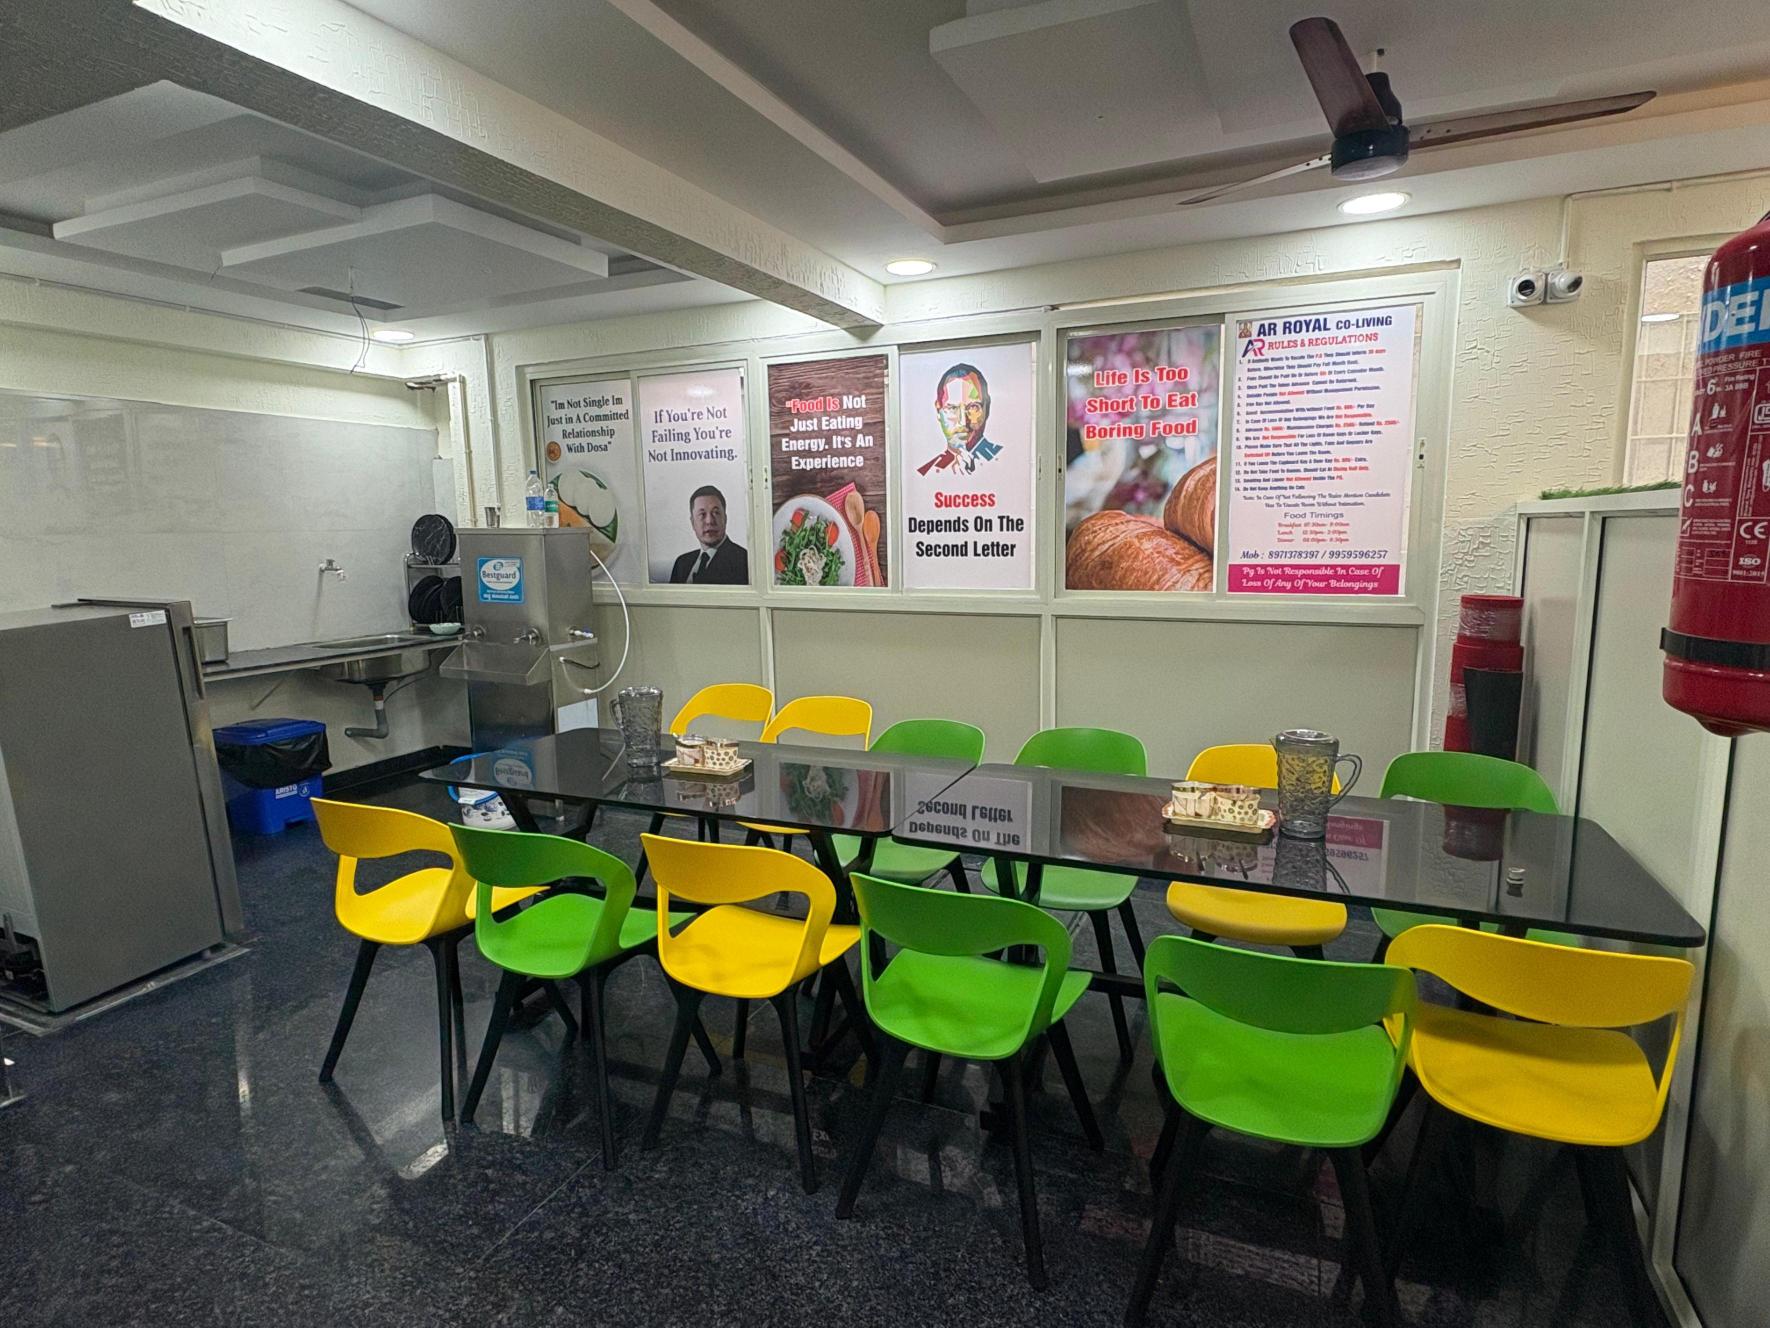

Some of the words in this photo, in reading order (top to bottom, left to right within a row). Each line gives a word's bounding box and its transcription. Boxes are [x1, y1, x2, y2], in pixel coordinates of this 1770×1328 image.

[1257, 321, 1276, 336] AR
[1282, 317, 1331, 334] ROYAL
[1336, 315, 1392, 329] CO-LIVING
[1267, 339, 1297, 350] RULES
[1299, 338, 1304, 347] &
[1307, 332, 1378, 346] REGULATIONS
[1739, 349, 1761, 360] FIRE
[1095, 371, 1128, 386] Life
[1133, 369, 1150, 384] Is
[1156, 367, 1189, 382] Too
[1707, 378, 1716, 395] 6
[567, 398, 581, 409] Not
[583, 395, 610, 409] Single
[611, 395, 623, 406] Im
[826, 396, 840, 412] Is
[842, 394, 866, 409] Not
[1086, 397, 1136, 413] Short
[1140, 395, 1161, 410] To
[1167, 393, 1198, 408] Eat
[547, 415, 563, 428] Just
[564, 414, 574, 424] in
[575, 413, 582, 424] A
[583, 409, 630, 423] Committed
[654, 409, 664, 424] If
[665, 408, 704, 423] You're
[706, 406, 727, 420] Not
[790, 418, 818, 432] Just
[821, 415, 863, 430] Eating
[1691, 412, 1702, 436] A
[562, 425, 615, 439] Relationship
[651, 428, 692, 444] Failing
[693, 425, 732, 441] You're
[1085, 423, 1145, 439] Boring
[1151, 419, 1198, 436] Food
[566, 442, 585, 453] With
[586, 441, 612, 453] Dosa"
[781, 437, 829, 451] Energy.
[832, 435, 852, 449] It's
[855, 433, 874, 448] An
[648, 449, 668, 463] Not
[670, 445, 738, 462] Innovating.
[791, 455, 864, 470] Experience
[1687, 450, 1699, 473] B
[934, 491, 996, 508] Success
[1684, 484, 1695, 507] C
[1309, 511, 1344, 519] Timings
[908, 516, 969, 535] Depends
[973, 515, 993, 532] On
[997, 515, 1024, 532] The
[1739, 521, 1769, 539] CE
[915, 540, 968, 557] Second
[973, 540, 1016, 557] Letter
[1240, 550, 1259, 559] Mob
[1268, 550, 1318, 559] 8971378397
[1328, 550, 1387, 559] 9959596257
[1738, 556, 1761, 566] ISO
[482, 570, 517, 581] Bestguard
[1242, 566, 1254, 576] Pg
[1256, 566, 1264, 574] Is
[1266, 566, 1282, 574] Not
[1283, 566, 1334, 578] Responsible
[1336, 567, 1346, 575] In
[1348, 567, 1370, 575] Case
[1371, 566, 1383, 578] Of
[1263, 579, 1274, 589] Of
[1274, 578, 1291, 589] Any
[1293, 579, 1305, 589] Of
[1304, 579, 1326, 587] Your
[1328, 579, 1378, 590] Belongings
